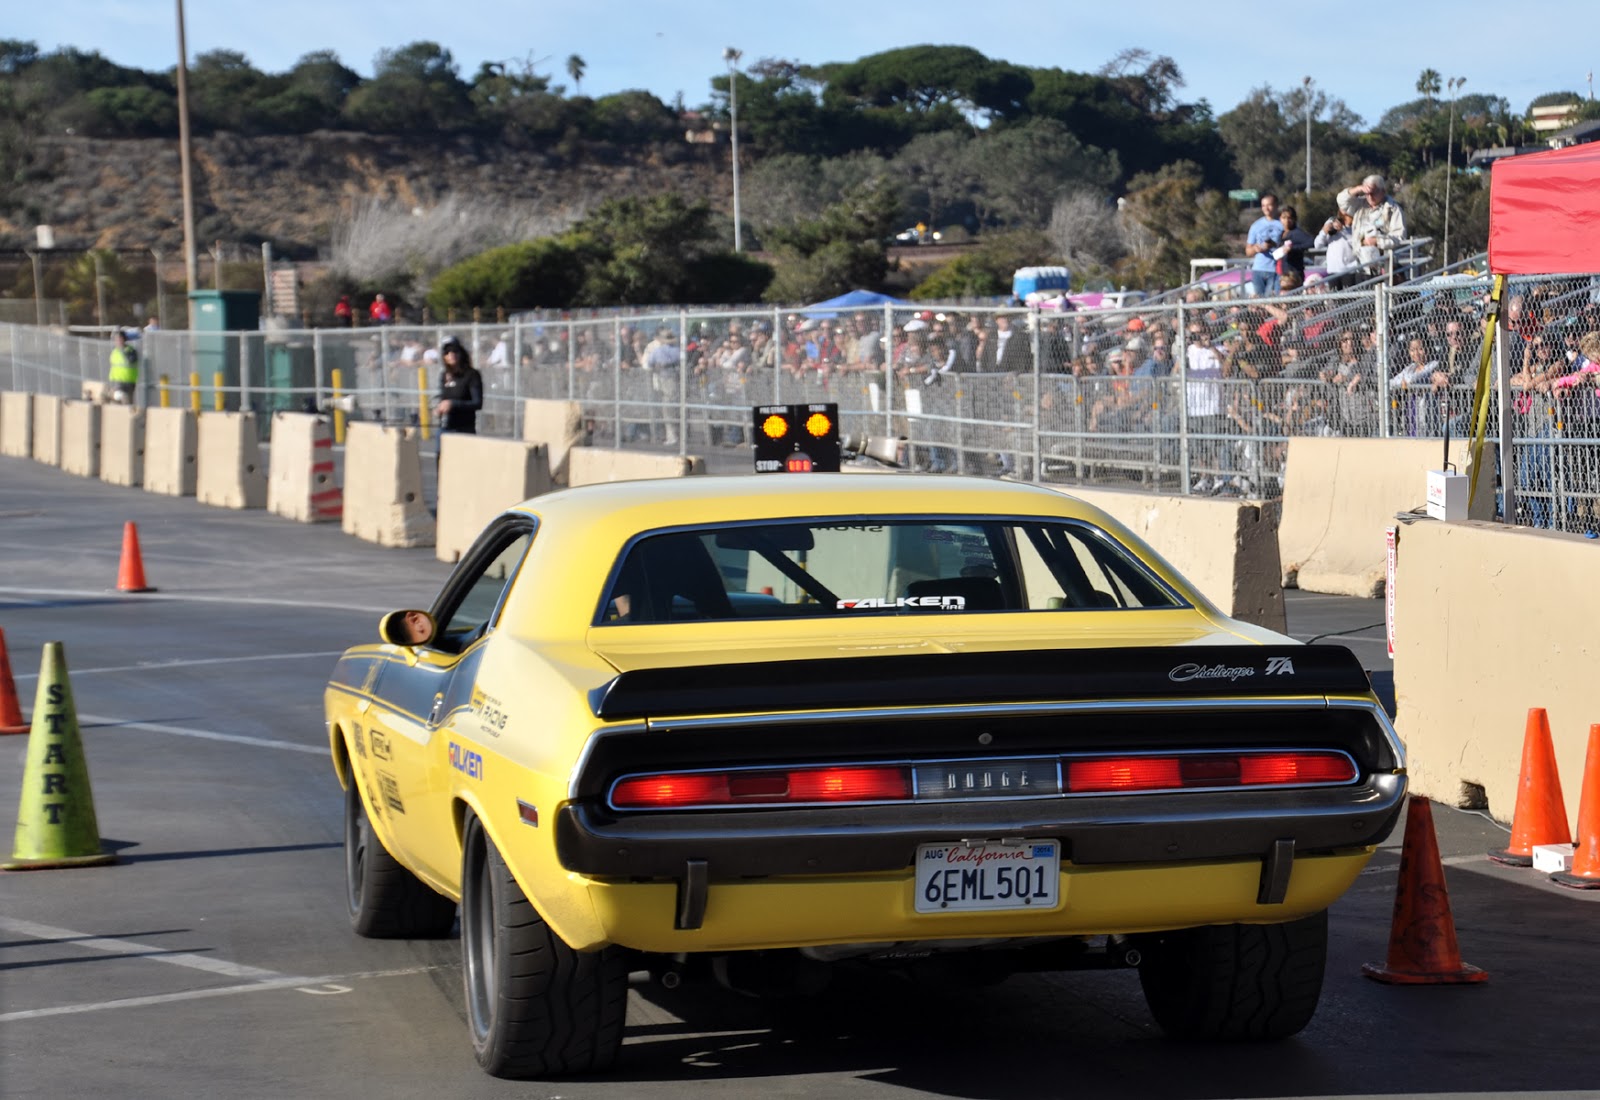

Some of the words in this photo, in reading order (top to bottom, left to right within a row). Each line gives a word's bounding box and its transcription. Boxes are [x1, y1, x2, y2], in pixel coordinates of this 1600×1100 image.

[808, 404, 826, 412] STAGE
[756, 460, 779, 471] STOP
[836, 595, 965, 609] FALKEN
[1168, 662, 1256, 682] Challenger
[42, 683, 69, 825] START
[448, 741, 482, 781] FALKEN
[947, 770, 1029, 789] DODGE
[924, 849, 943, 860] AUG
[947, 846, 1034, 866] California
[925, 866, 1048, 902] 6EML501
